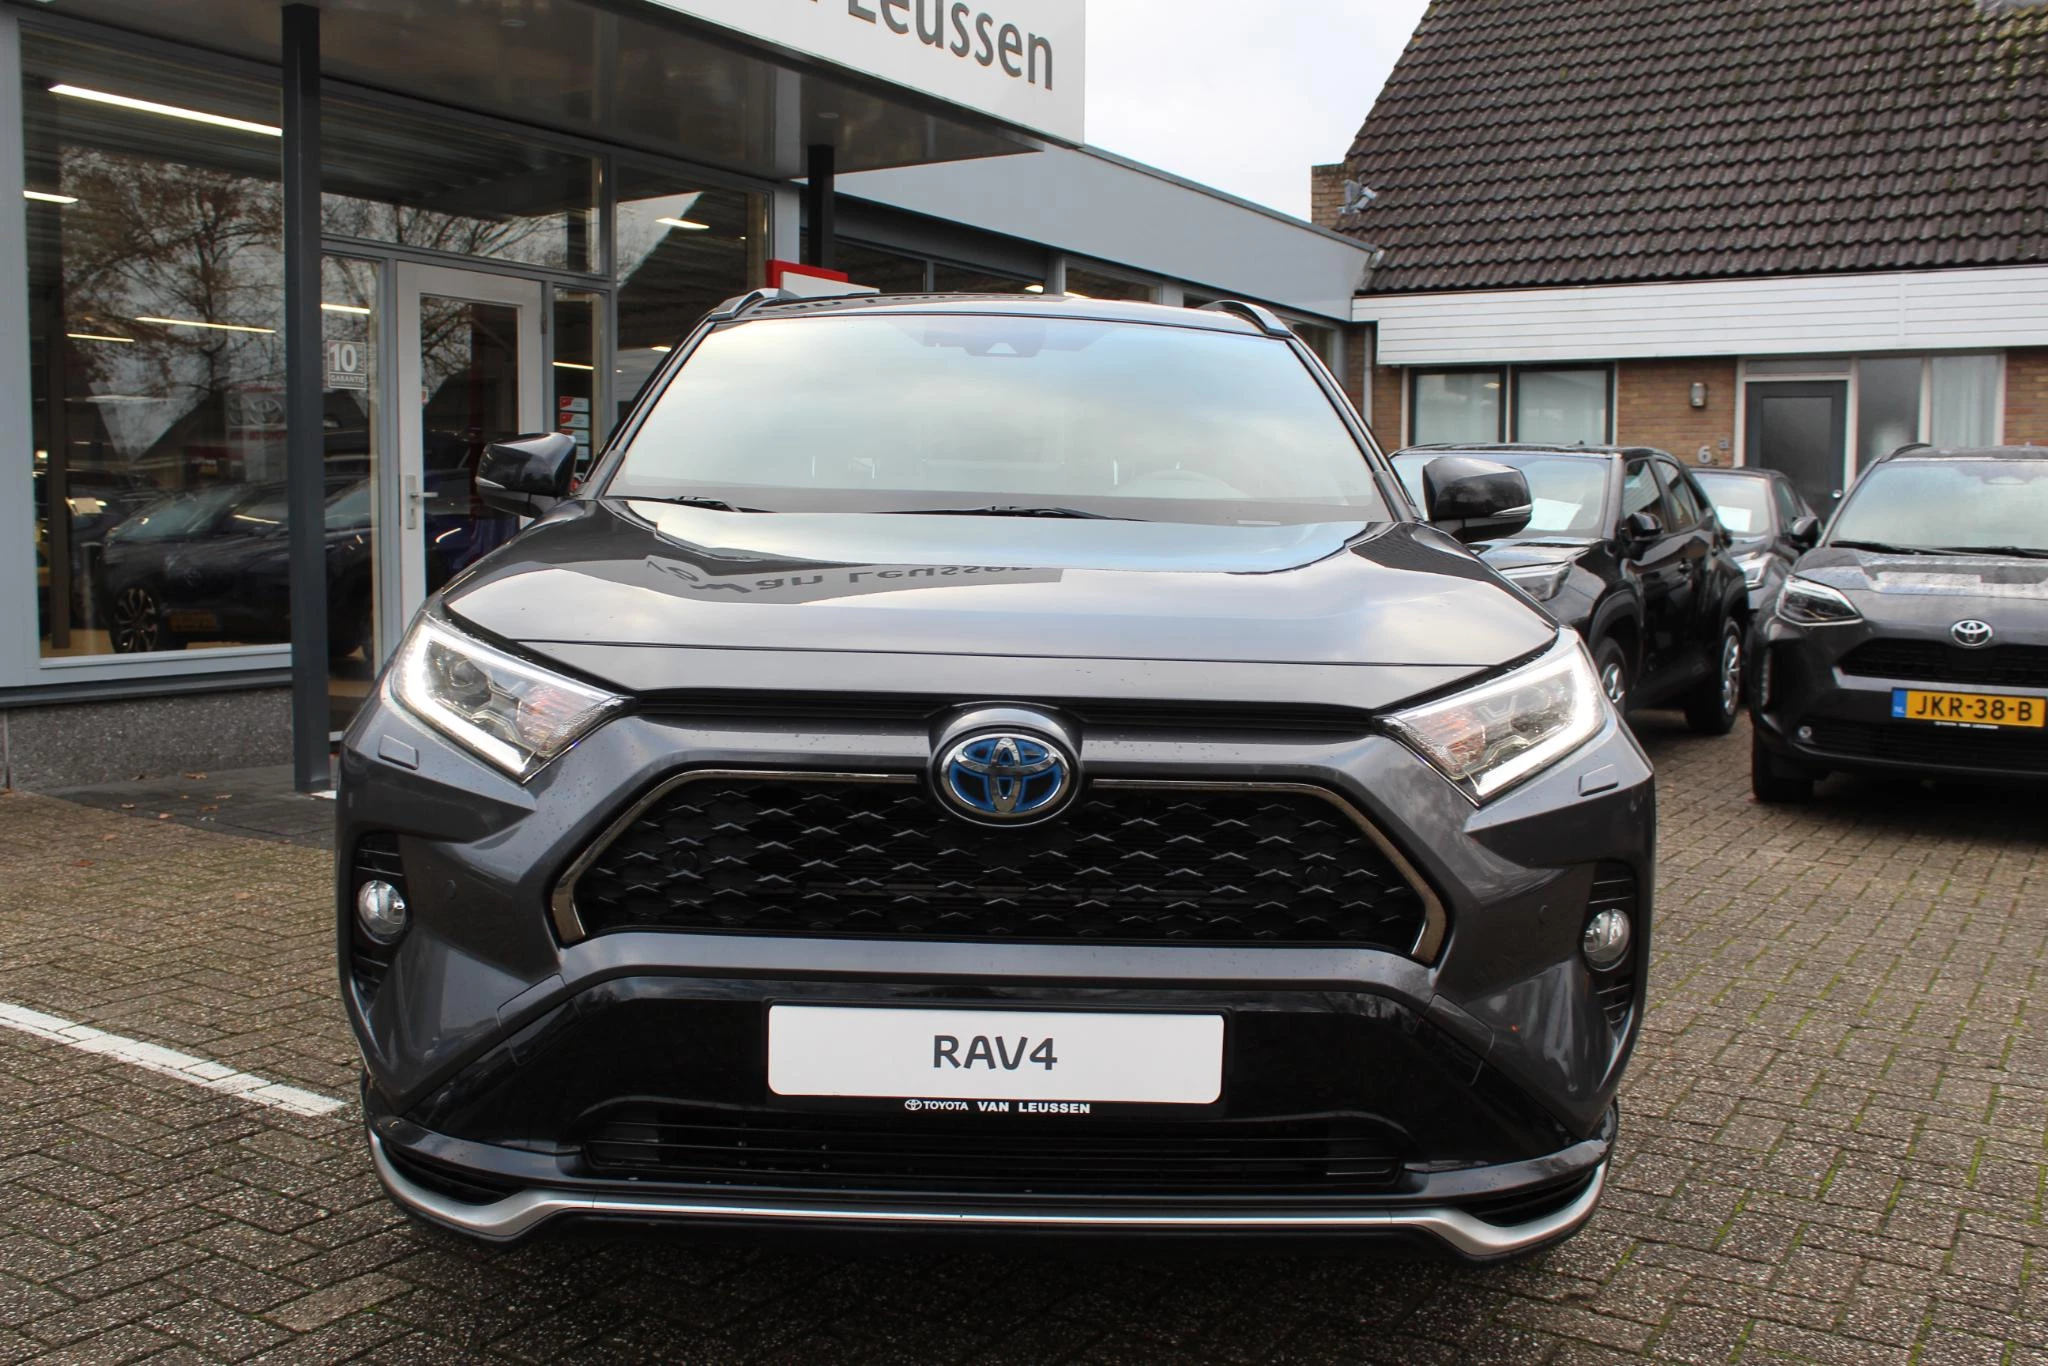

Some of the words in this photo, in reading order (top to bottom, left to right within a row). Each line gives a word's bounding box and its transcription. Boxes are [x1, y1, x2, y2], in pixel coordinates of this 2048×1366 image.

[330, 343, 357, 372] 10
[1697, 445, 1712, 464] 6
[1916, 695, 2032, 721] JKR-38-B
[933, 1034, 1058, 1071] RAV4
[923, 1100, 969, 1111] TOYOTA
[977, 1101, 1010, 1113] VAN
[1018, 1102, 1090, 1114] LEUSSEN
